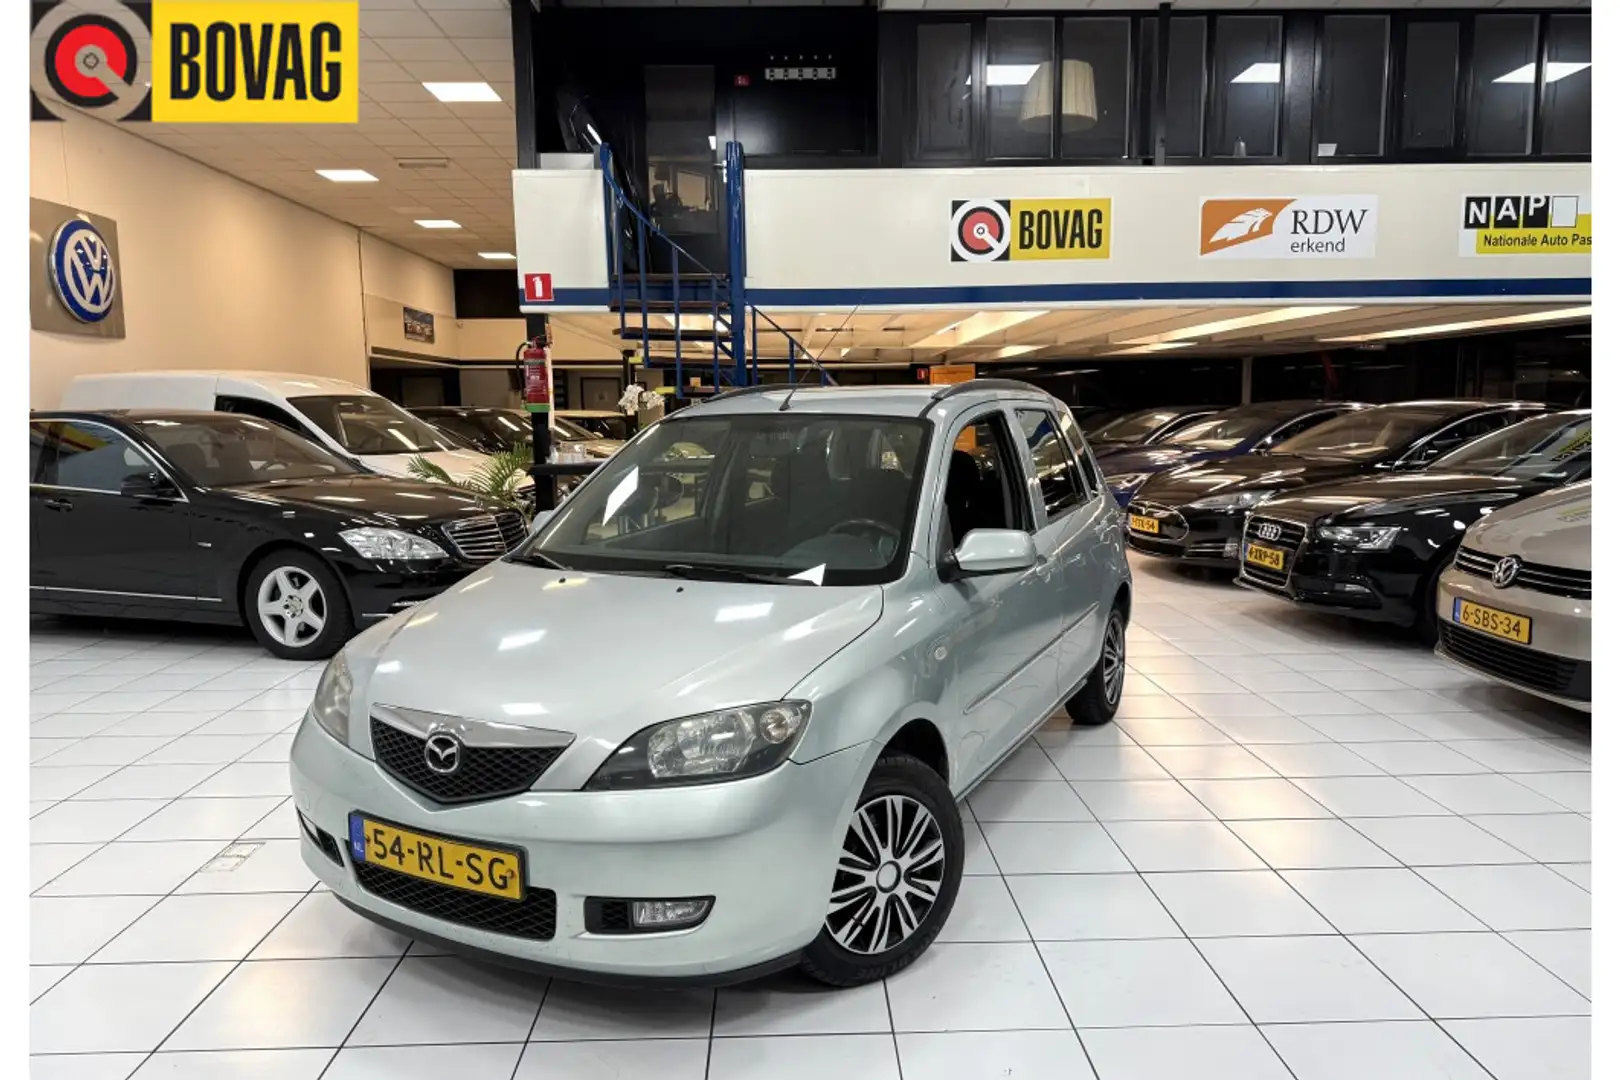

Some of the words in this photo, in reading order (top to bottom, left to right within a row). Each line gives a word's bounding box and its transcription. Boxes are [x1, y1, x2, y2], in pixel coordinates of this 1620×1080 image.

[1291, 209, 1369, 235] RDW
[1468, 196, 1546, 224] NAP
[1019, 208, 1103, 250] BOVAG
[1483, 234, 1538, 247] Nationale
[1540, 234, 1568, 246] Auto
[1290, 237, 1346, 253] erkend
[1463, 605, 1521, 637] 6-SBS-34
[373, 828, 509, 891] 54-RL-SG
